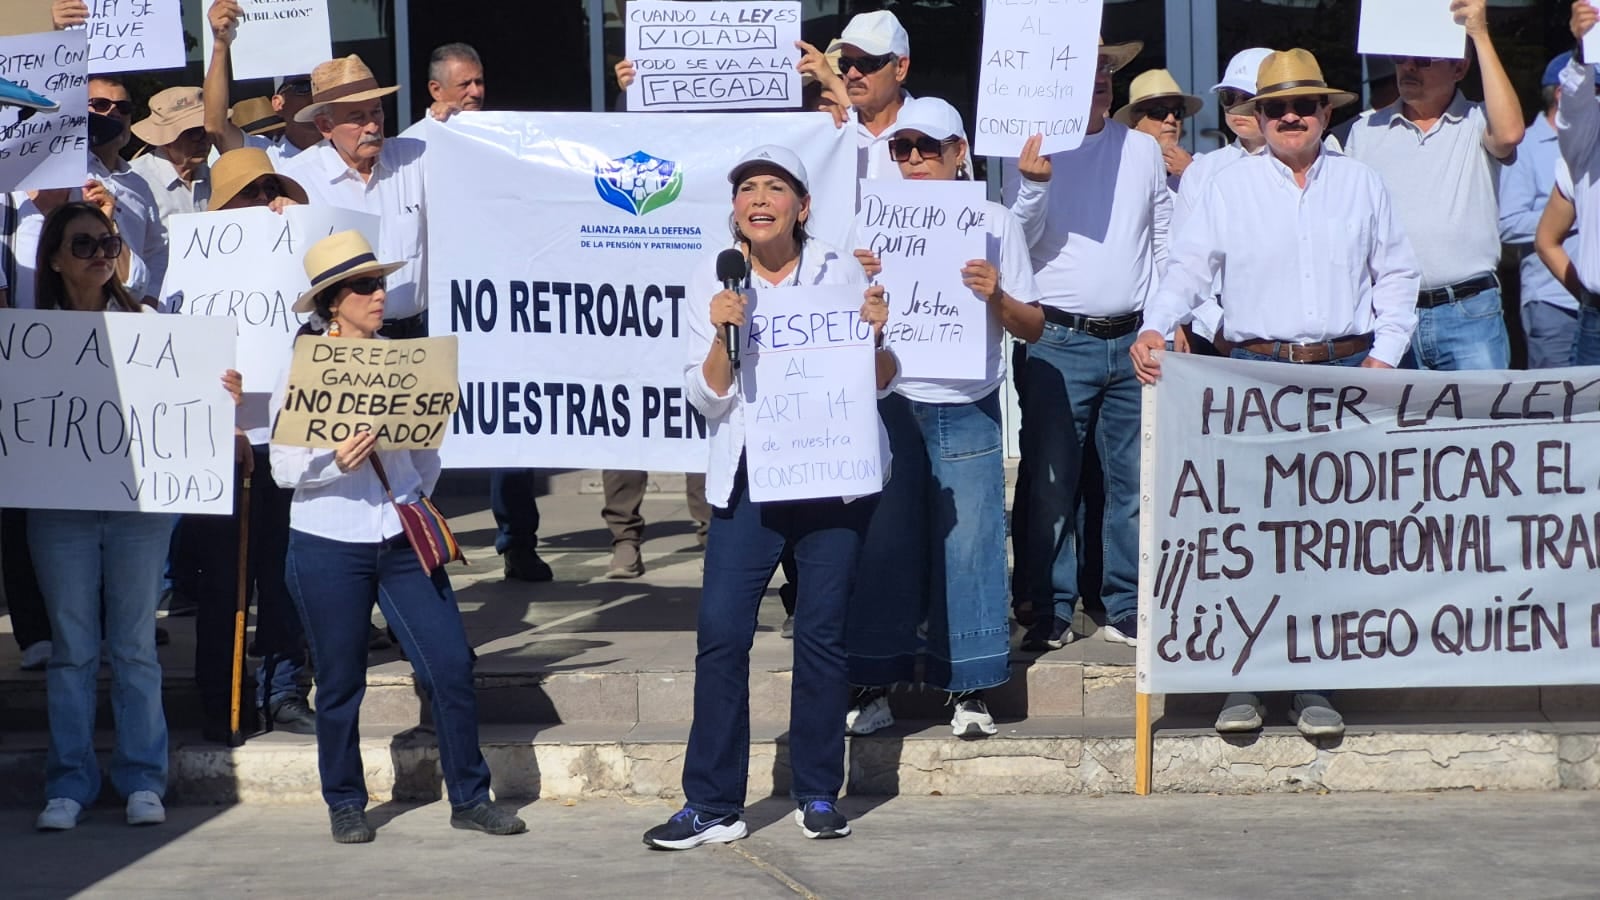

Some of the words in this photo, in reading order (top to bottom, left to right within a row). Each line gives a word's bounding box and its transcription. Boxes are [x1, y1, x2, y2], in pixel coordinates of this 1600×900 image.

[631, 9, 696, 23] CUANDO
[710, 10, 730, 23] LA
[738, 9, 773, 23] LEY
[774, 9, 797, 23] ES
[1020, 16, 1052, 35] AL
[87, 42, 145, 60] LOCA
[646, 28, 772, 47] VIOLADA
[634, 59, 676, 70] TODO
[687, 59, 708, 70] SE
[715, 59, 740, 70] VA
[748, 57, 764, 70] A
[770, 57, 793, 70] LA
[987, 49, 1030, 70] ART
[1050, 44, 1079, 71] 14
[650, 77, 784, 102] FREGADA
[986, 76, 1009, 96] de
[1018, 79, 1073, 99] nuestra
[20, 141, 42, 156] DE
[49, 135, 86, 154] CFE
[863, 194, 946, 230] DERECHO
[957, 206, 985, 236] QUE
[184, 223, 243, 260] NO
[272, 220, 296, 254] A
[580, 225, 620, 235] ALIANZA
[623, 225, 647, 235] PARA
[648, 226, 660, 235] LA
[661, 226, 702, 236] DEFENSA
[606, 239, 641, 249] PENSIÓN
[651, 242, 703, 250] PATRIMONIO
[870, 231, 926, 259] QUITA
[451, 278, 498, 333] NO
[510, 280, 686, 338] RETROACT
[747, 310, 871, 349] RESPETO
[75, 328, 110, 369] A
[127, 333, 180, 378] LA
[312, 343, 426, 365] DERECHO
[321, 368, 418, 390] GANADO
[784, 357, 824, 380] AL
[284, 384, 332, 413] ¡NO
[336, 392, 411, 416] DEBE
[413, 391, 455, 416] SER
[453, 381, 631, 438] NUESTRAS
[756, 391, 809, 424] ART
[827, 387, 856, 421] 14
[1202, 385, 1372, 435] HACER
[1398, 384, 1463, 427] LA
[1490, 379, 1600, 423] LEY
[762, 434, 781, 453] de
[792, 427, 851, 451] nuestra
[754, 456, 876, 490] CONSTITUCION
[1169, 459, 1240, 517] AL
[1264, 440, 1522, 509] MODIFICAR
[1537, 440, 1586, 494] EL
[120, 469, 224, 506] VIDAD
[1258, 501, 1454, 575] TRAICIÓN
[1458, 514, 1507, 573] AL
[1287, 608, 1418, 663] LUEGO
[1431, 587, 1568, 656] QUIÉN
